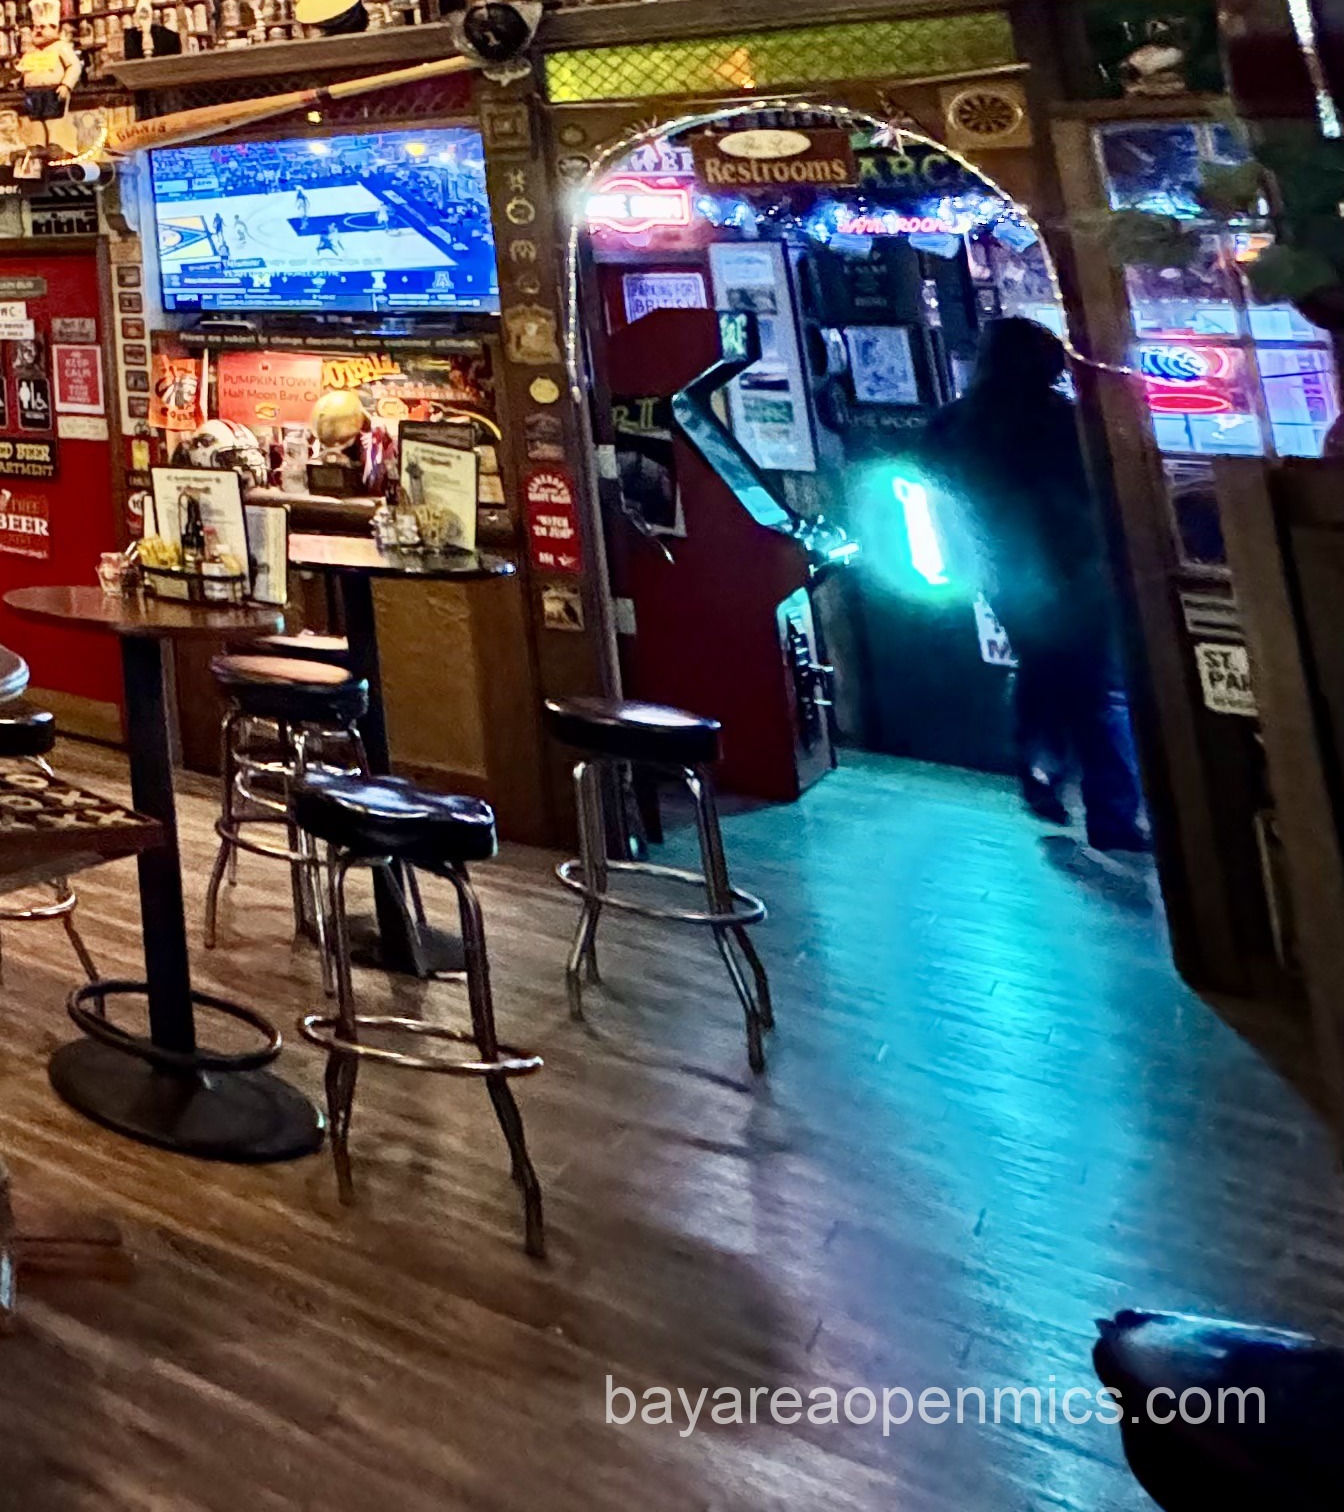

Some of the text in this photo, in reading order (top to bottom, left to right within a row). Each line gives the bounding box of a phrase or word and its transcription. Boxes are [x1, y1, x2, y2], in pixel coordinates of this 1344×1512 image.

[704, 157, 849, 185] Restrooms
[223, 374, 318, 387] PUMPKIN TOWN
[245, 388, 277, 400] Moon
[16, 442, 51, 462] BEER
